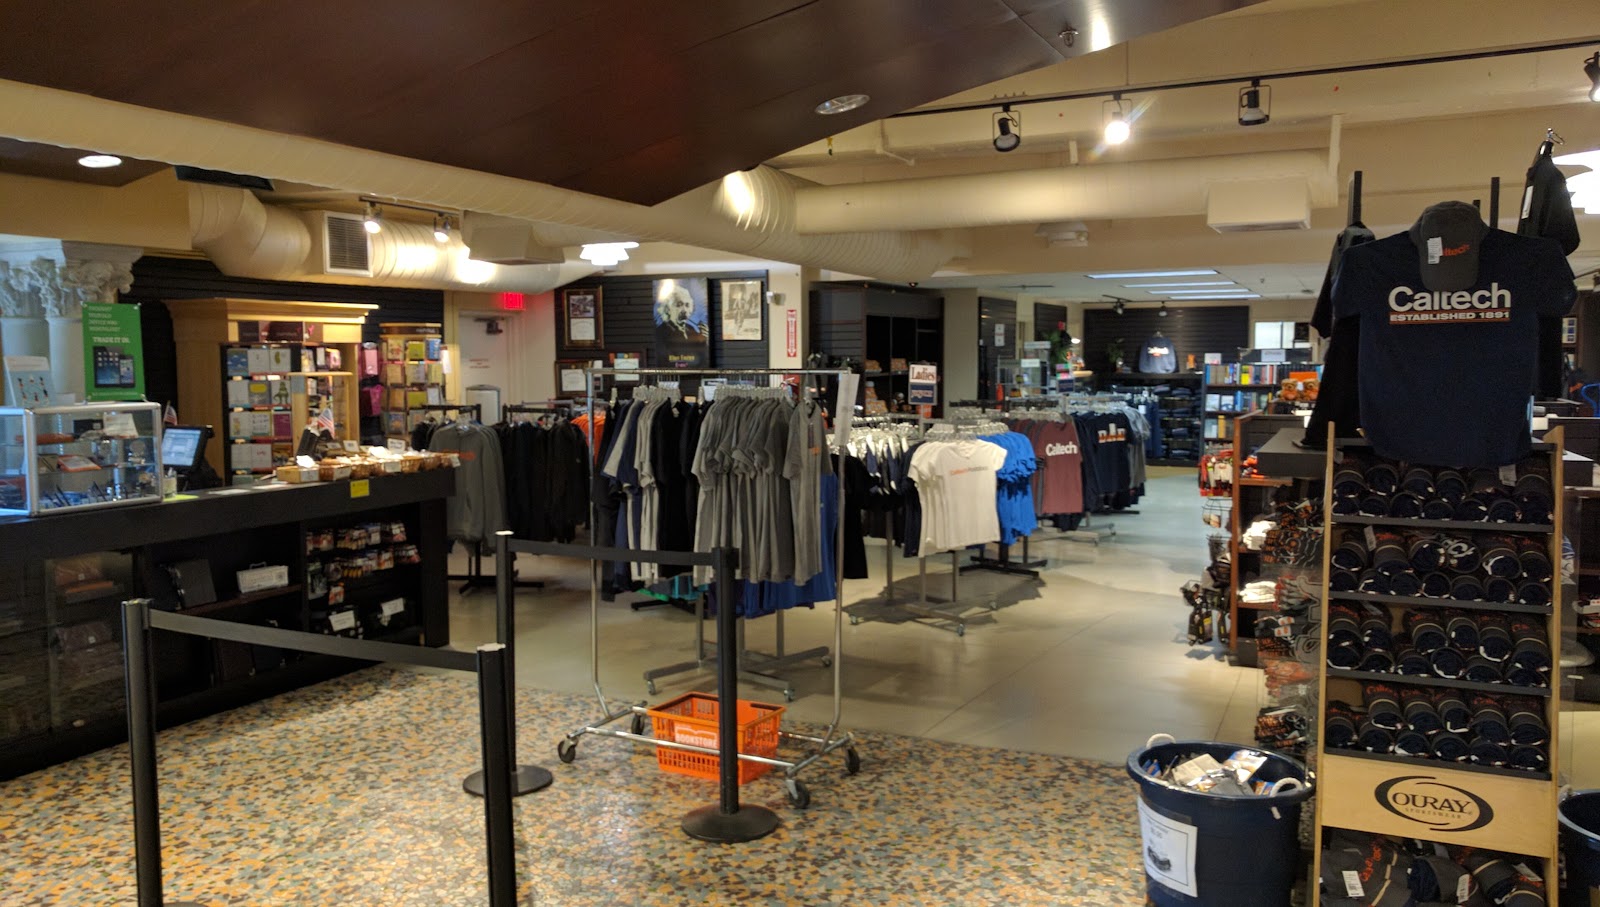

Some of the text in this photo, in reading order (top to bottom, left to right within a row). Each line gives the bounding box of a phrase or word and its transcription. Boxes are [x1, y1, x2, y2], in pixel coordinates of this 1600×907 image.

[1388, 282, 1512, 312] Caltech
[1389, 311, 1510, 322] ESTABLISHED 1891
[1045, 441, 1079, 457] Caltech
[1391, 792, 1471, 814] OURAY
[1404, 807, 1462, 820] SPORTSWEAR
